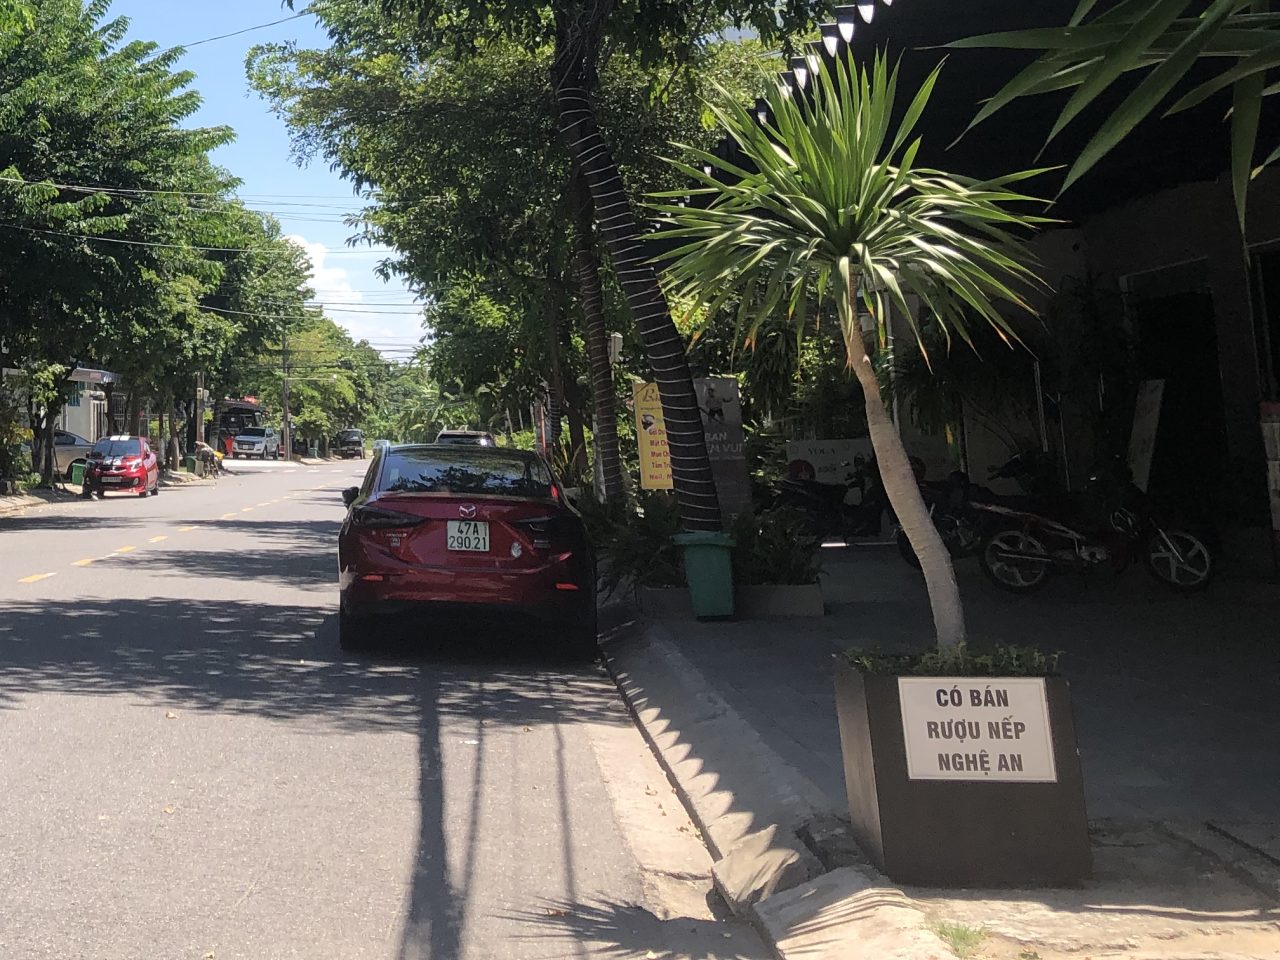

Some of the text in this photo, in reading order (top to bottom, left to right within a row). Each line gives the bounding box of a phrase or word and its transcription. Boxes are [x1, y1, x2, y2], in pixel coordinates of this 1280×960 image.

[458, 521, 479, 535] 47A
[449, 536, 486, 549] 290.21
[936, 685, 1009, 707] CÓ BÁN
[926, 715, 1026, 743] RƯỢU NẾP
[937, 749, 1024, 776] NGHỆ AN
